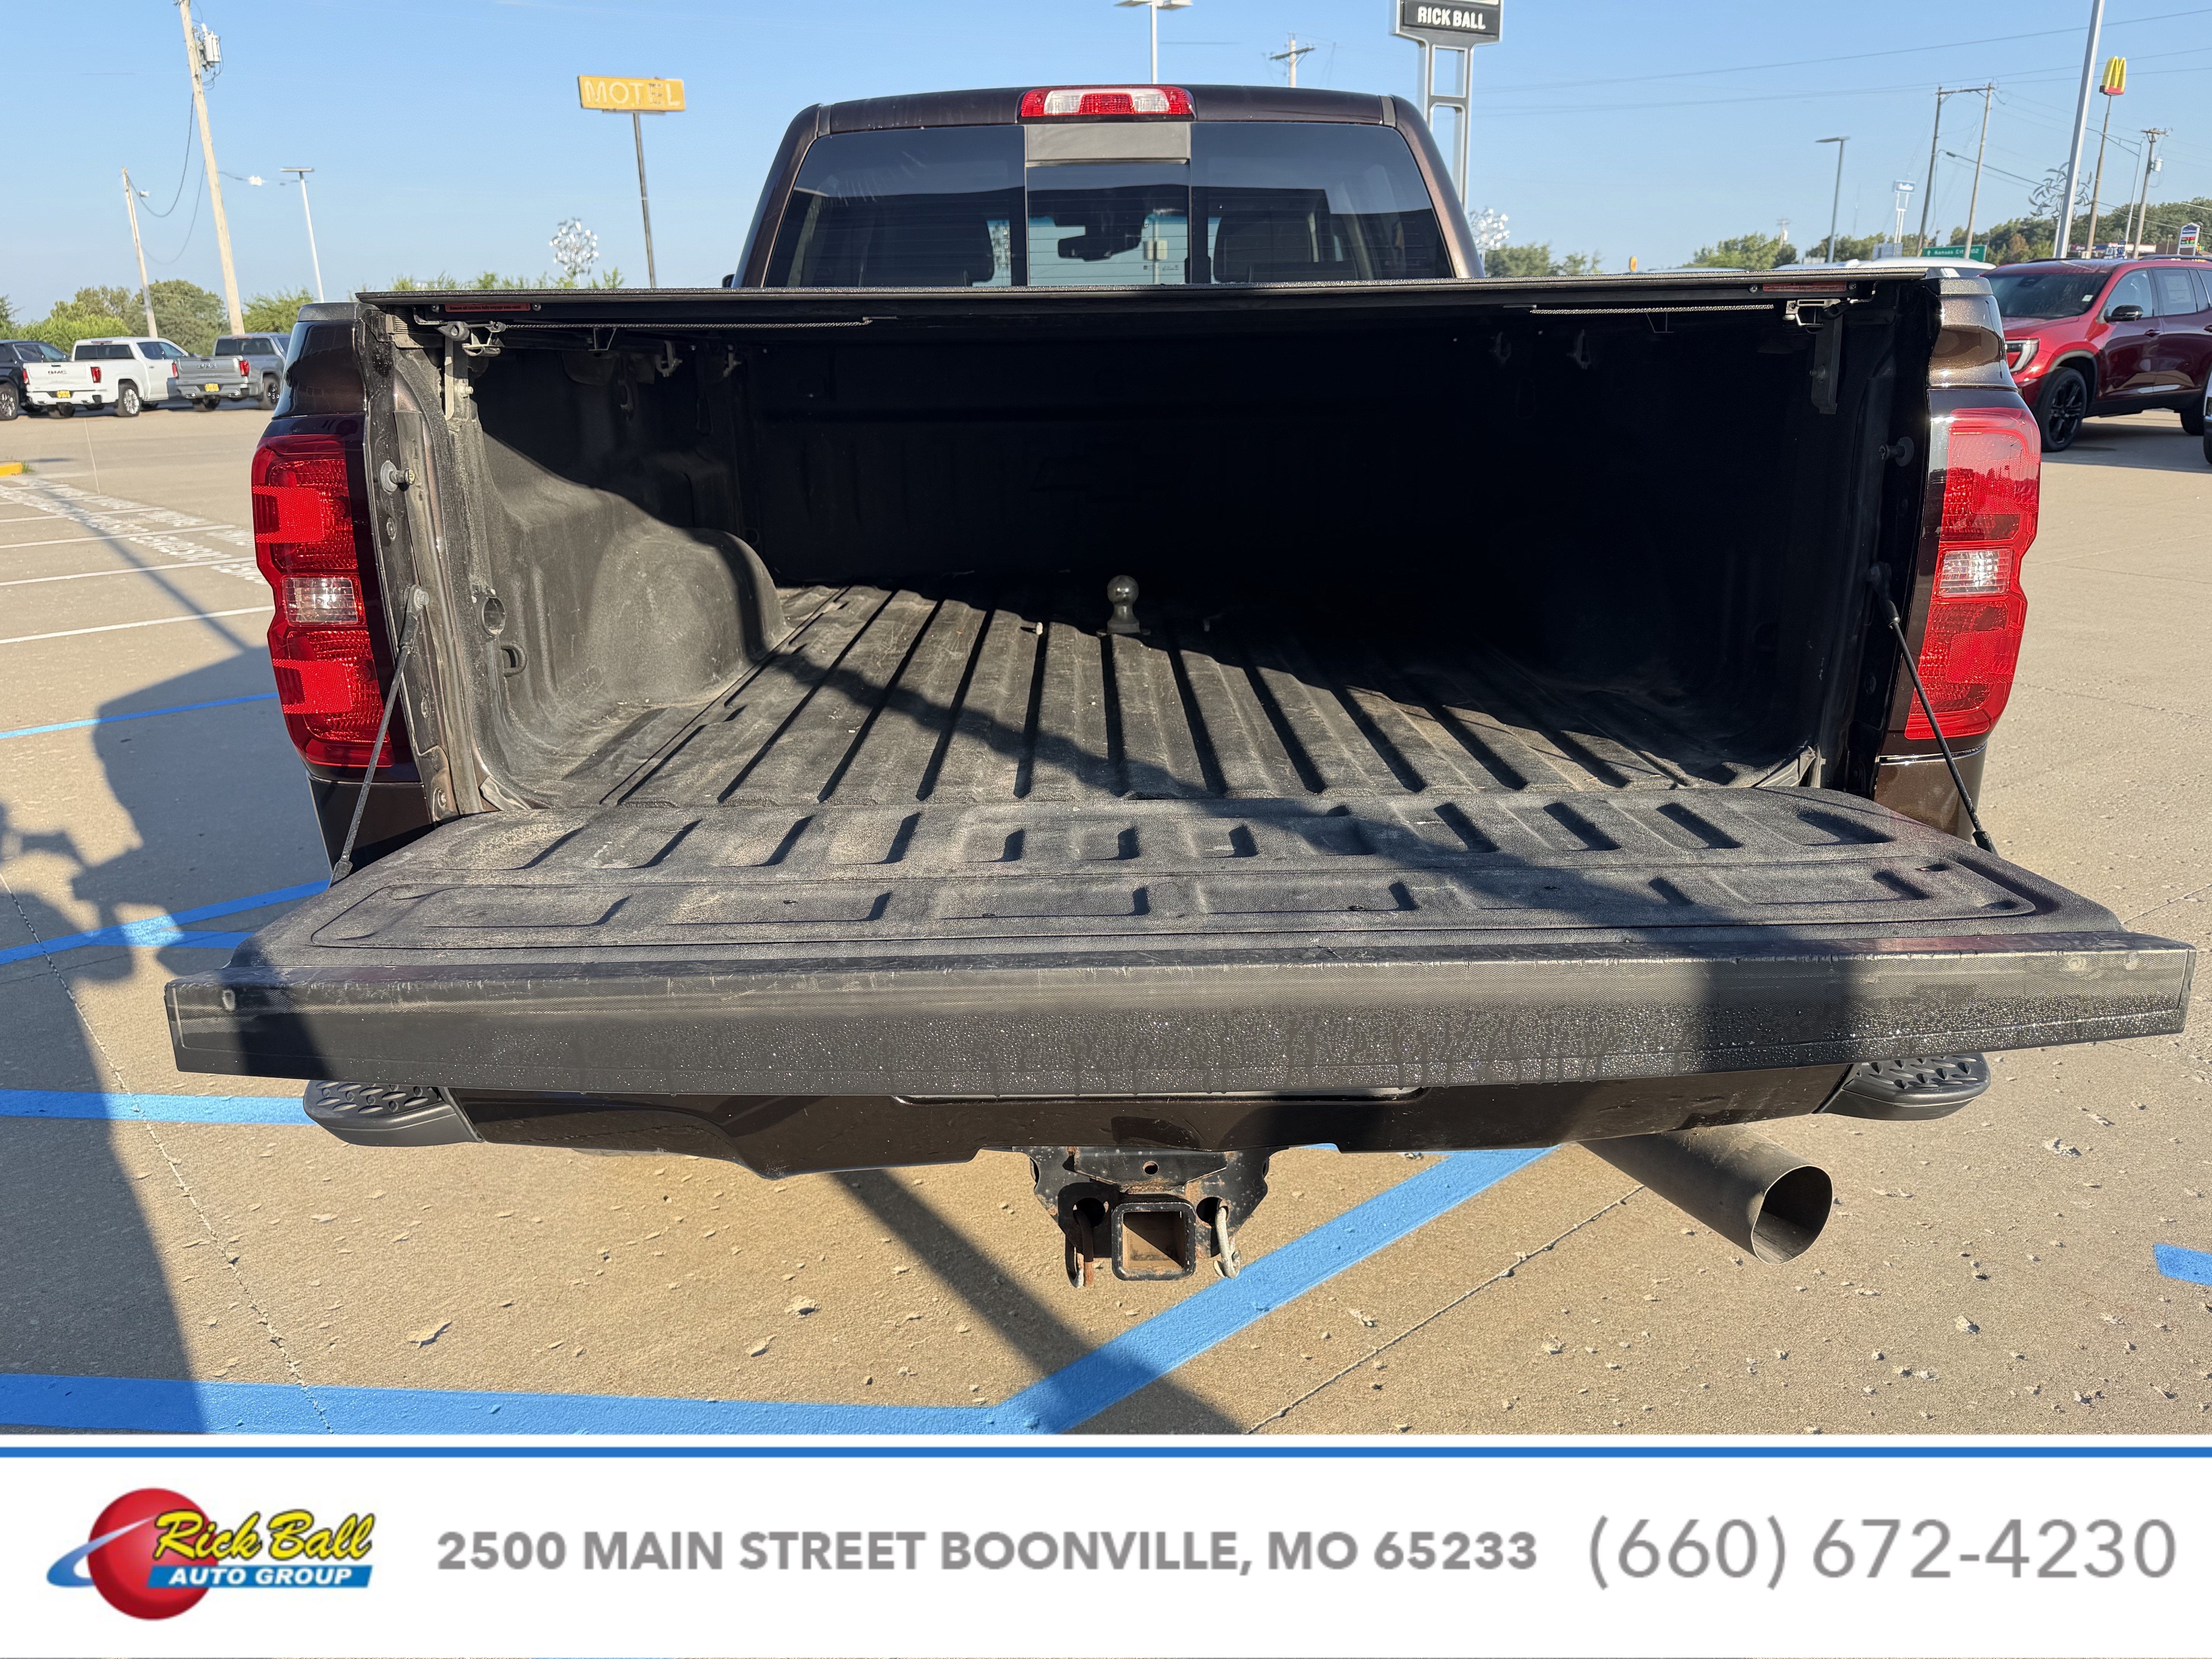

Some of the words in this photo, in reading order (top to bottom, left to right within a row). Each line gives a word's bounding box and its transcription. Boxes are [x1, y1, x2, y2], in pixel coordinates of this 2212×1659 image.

[1417, 6, 1451, 26] RICK
[1453, 10, 1486, 30] BALL
[584, 80, 681, 106] MOTEL
